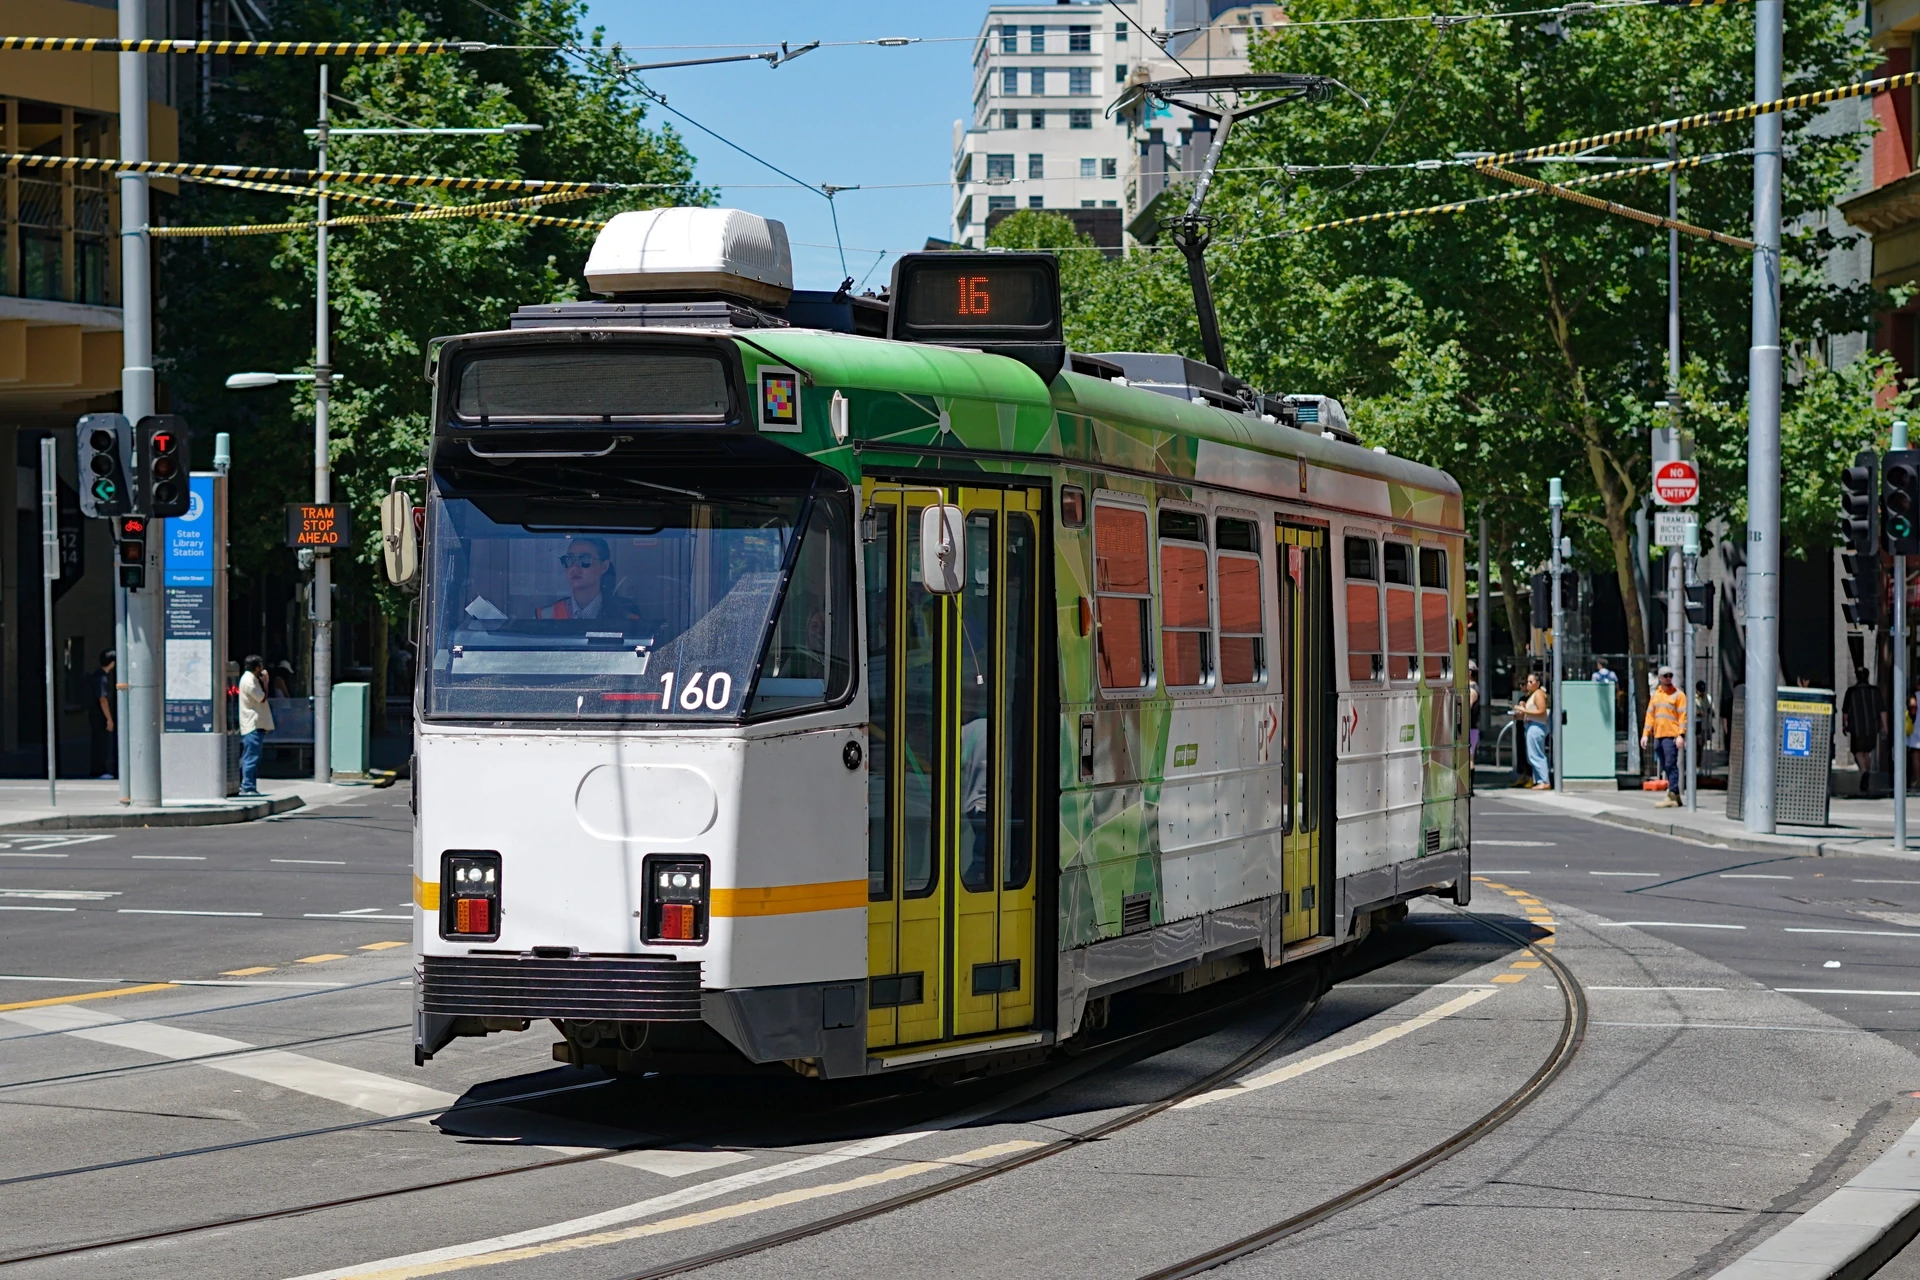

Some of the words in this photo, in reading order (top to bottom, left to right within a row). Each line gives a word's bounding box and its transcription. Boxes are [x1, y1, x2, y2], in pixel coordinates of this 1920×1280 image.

[958, 276, 989, 314] 16
[1669, 467, 1684, 478] NO
[1660, 488, 1693, 498] ENTRY
[300, 507, 335, 519] TRAM
[1662, 515, 1686, 523] TRAMS
[303, 519, 334, 531] STOP
[1660, 525, 1684, 533] BICYCL
[176, 529, 201, 538] State
[297, 532, 339, 544] AHEAD
[1659, 534, 1685, 542] EXCEPT
[61, 533, 77, 548] 12
[172, 539, 204, 549] Library
[61, 550, 78, 564] 14
[172, 548, 205, 557] Station
[660, 671, 732, 710] 160
